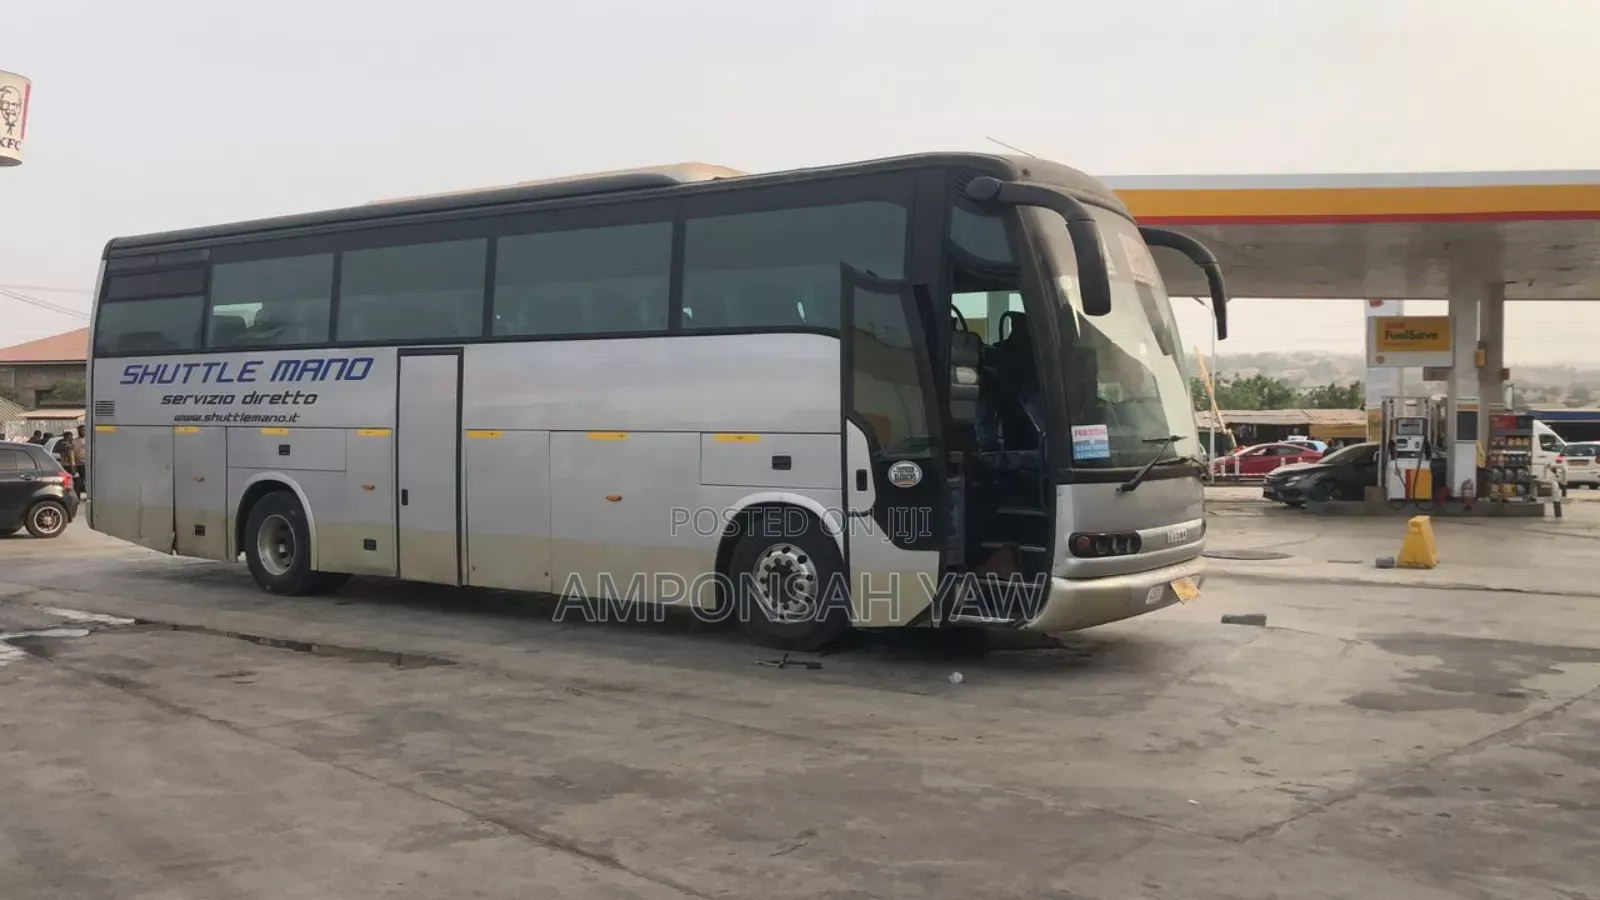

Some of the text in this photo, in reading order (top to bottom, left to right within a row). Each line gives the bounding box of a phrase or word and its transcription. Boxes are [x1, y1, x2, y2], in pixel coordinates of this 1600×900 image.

[1384, 330, 1438, 341] FuelSave
[120, 357, 375, 384] SHUTTLE MANO
[160, 390, 318, 406] servizio diretto
[174, 412, 301, 423] www.shuttlemano.it
